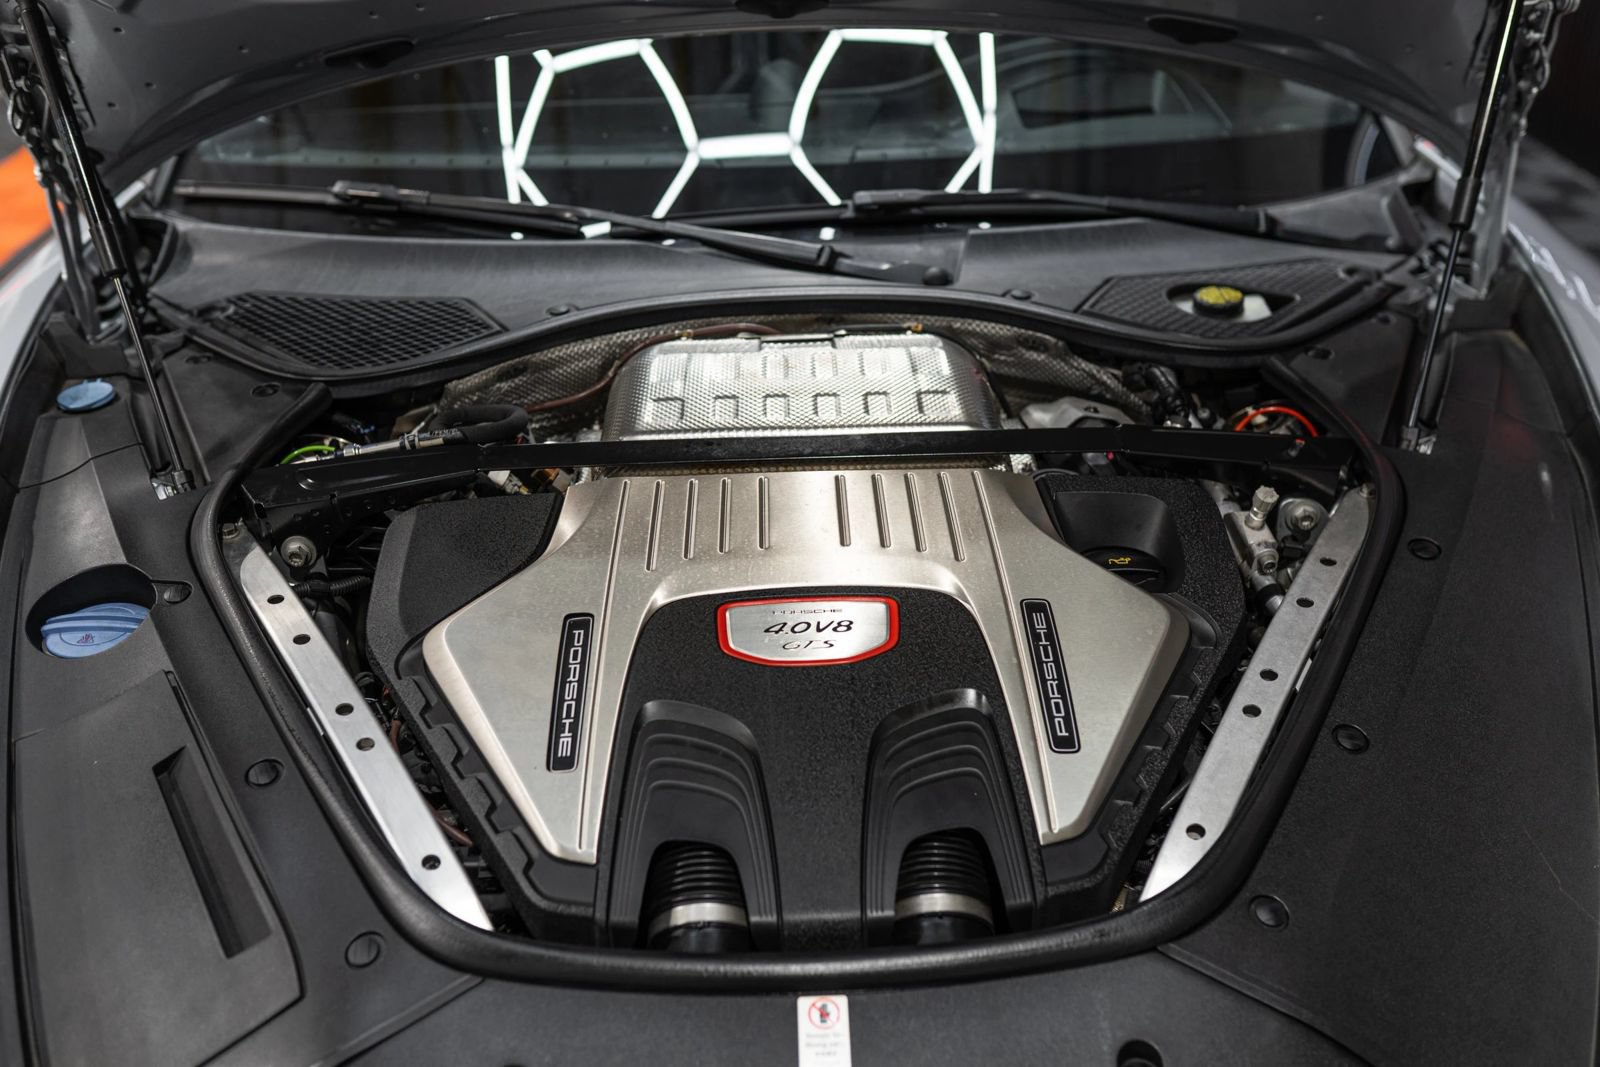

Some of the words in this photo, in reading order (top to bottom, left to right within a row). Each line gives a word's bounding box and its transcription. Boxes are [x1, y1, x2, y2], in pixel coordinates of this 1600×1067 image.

[557, 629, 585, 758] PORSCHE
[782, 639, 836, 651] GTS
[1032, 612, 1069, 736] PORSCHE
